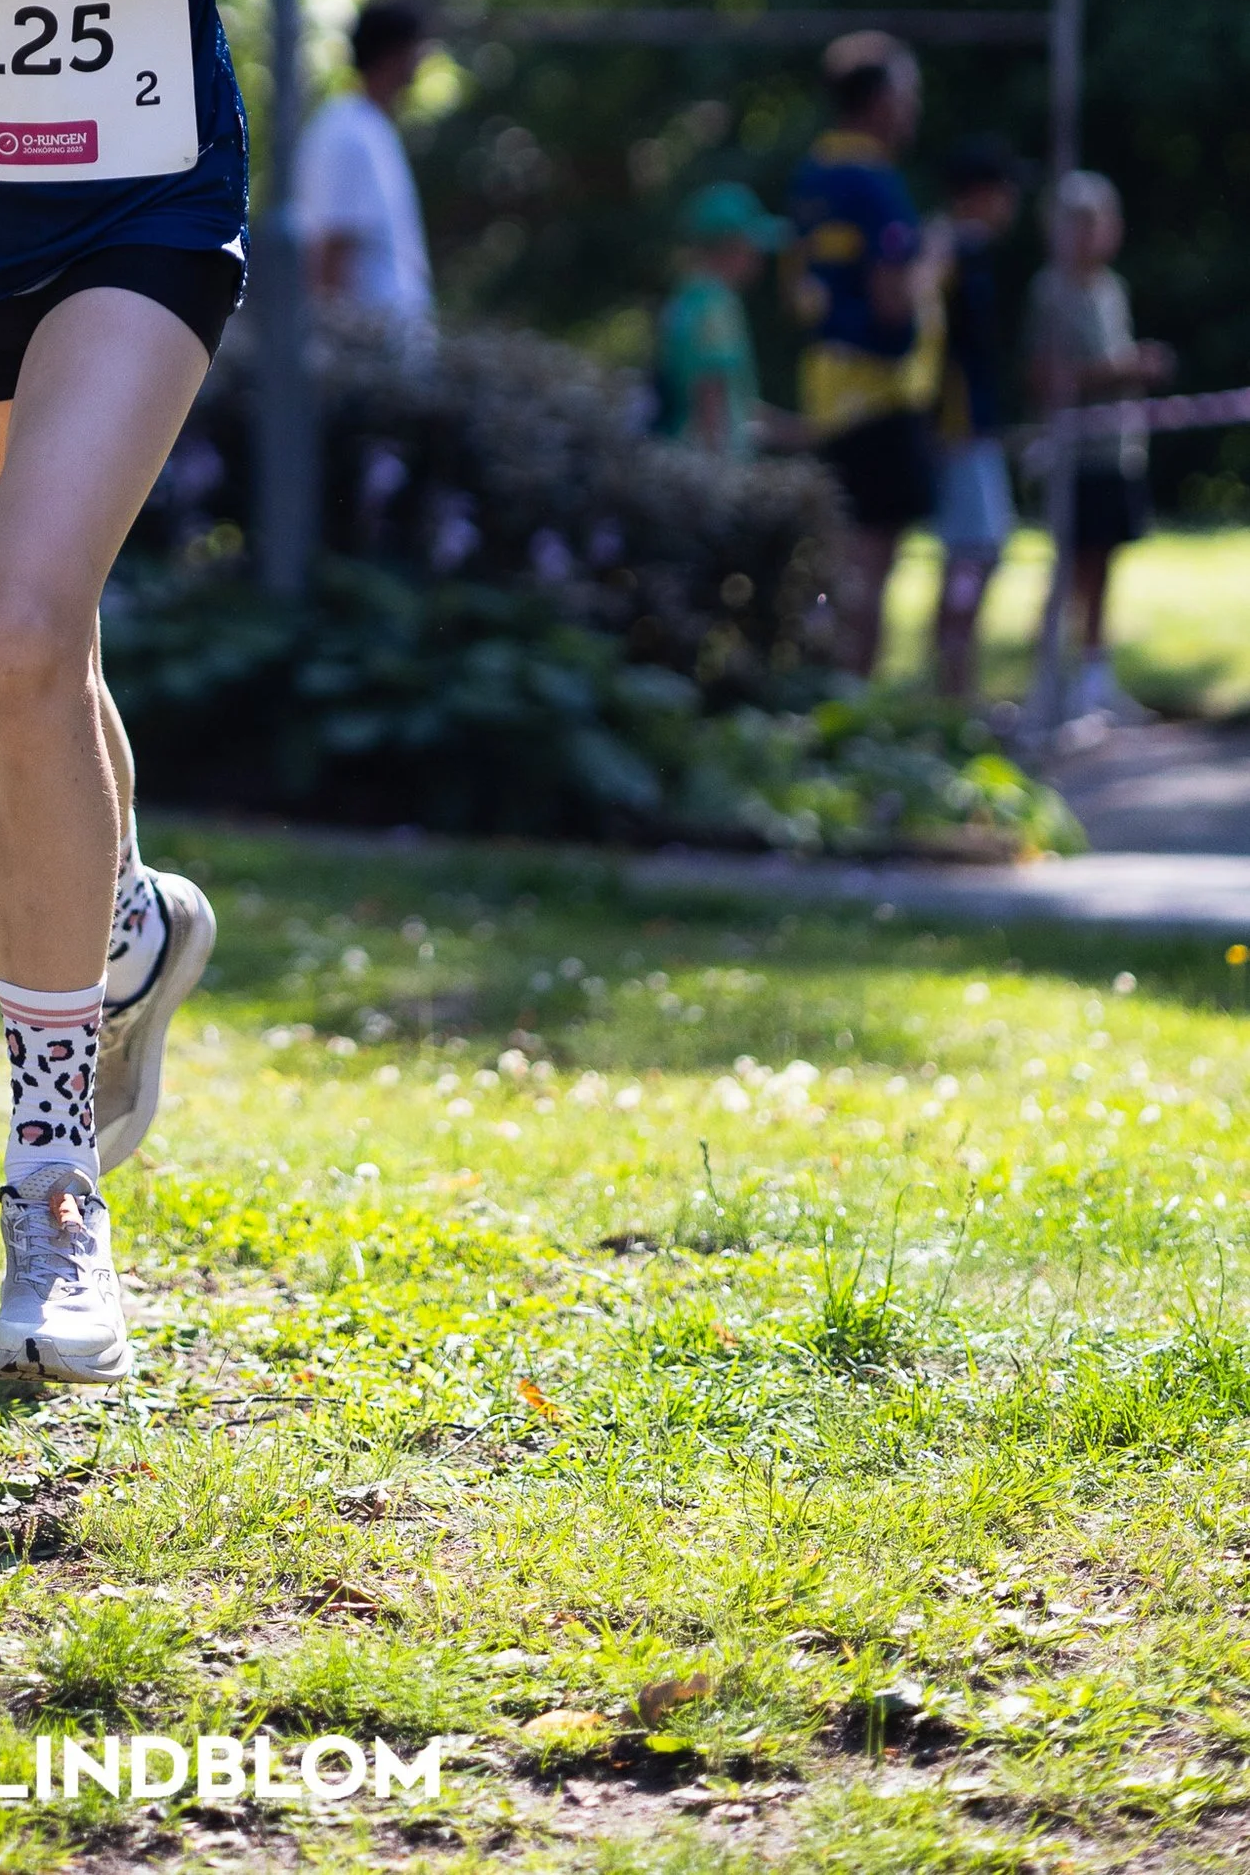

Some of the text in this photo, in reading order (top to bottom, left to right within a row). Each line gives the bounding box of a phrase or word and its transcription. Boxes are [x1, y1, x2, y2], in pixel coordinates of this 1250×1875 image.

[136, 70, 161, 106] 2
[22, 132, 87, 146] O-RINGEN
[23, 146, 65, 154] JÖNKÖPING
